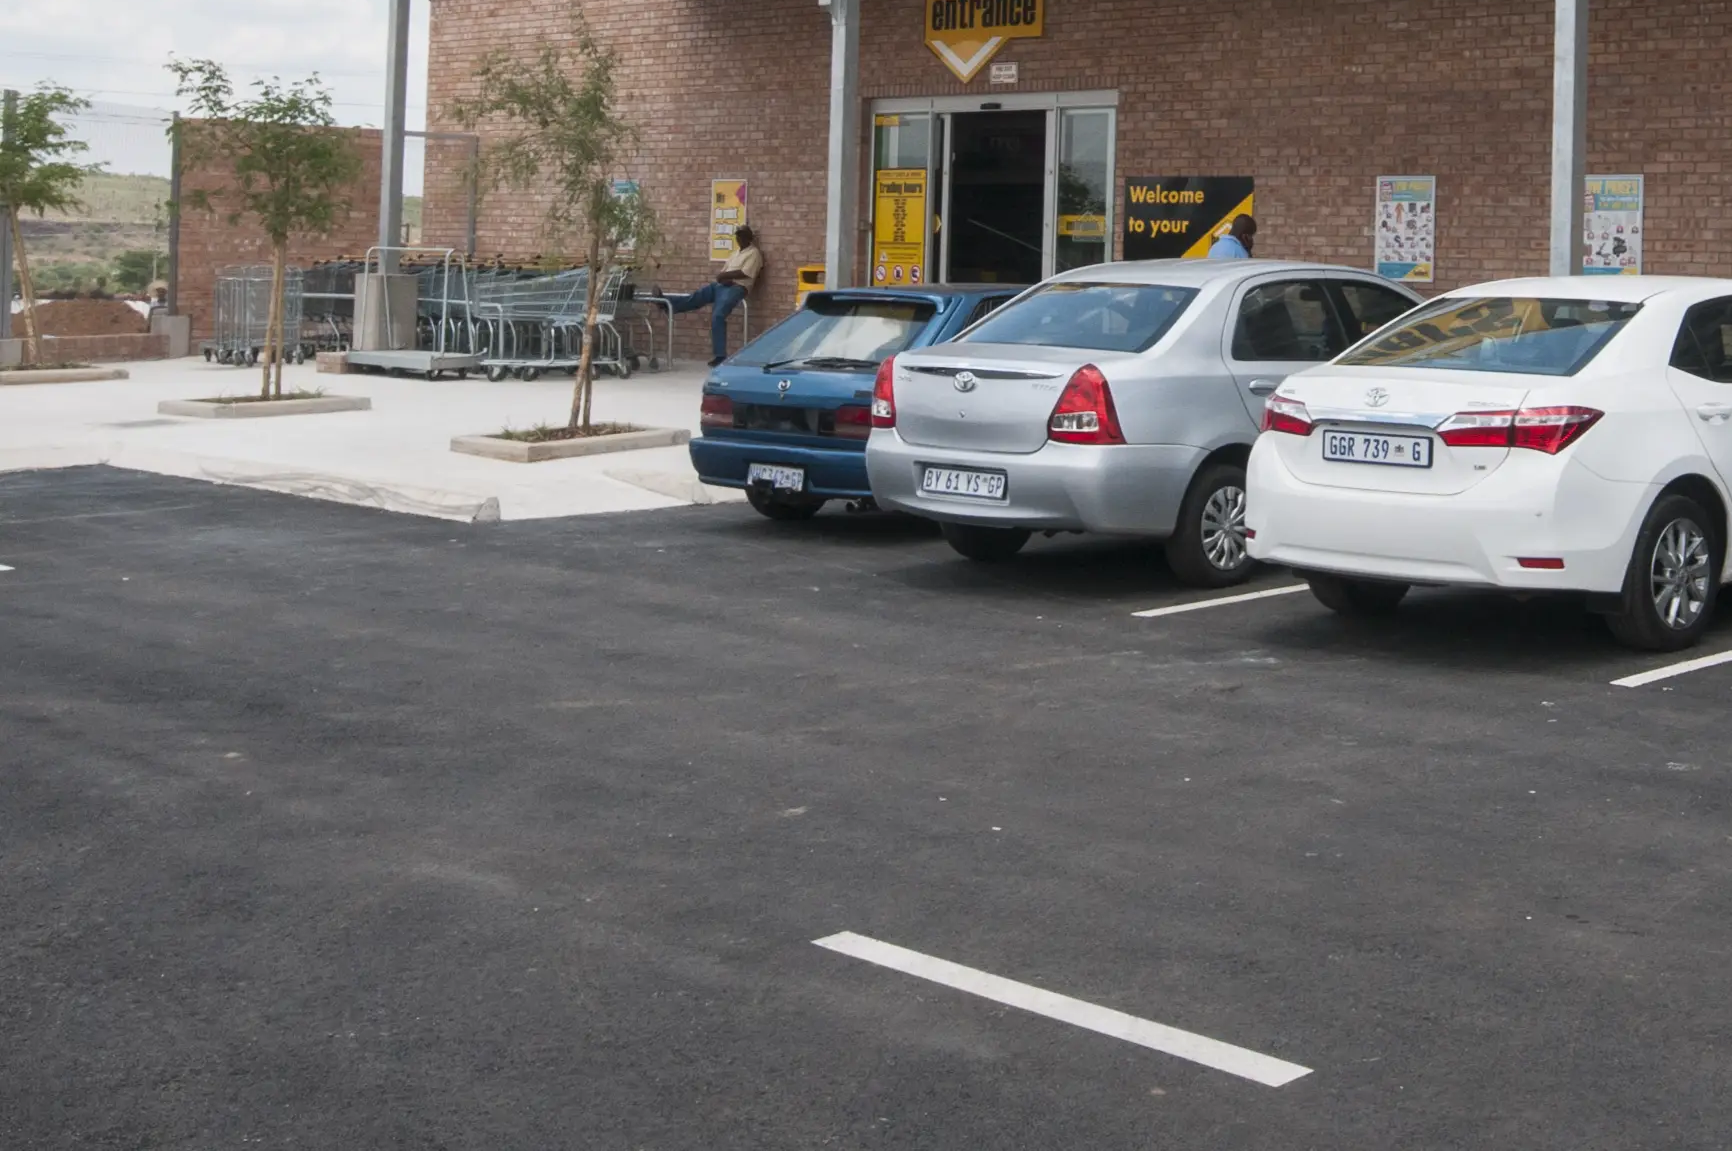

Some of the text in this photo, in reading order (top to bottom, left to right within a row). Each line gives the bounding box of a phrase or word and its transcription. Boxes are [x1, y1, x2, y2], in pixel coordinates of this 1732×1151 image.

[1129, 184, 1205, 204] Welcome
[1128, 216, 1189, 238] to your
[1330, 436, 1421, 462] GGR 739 G
[926, 470, 1003, 495] BY 61 YS GP
